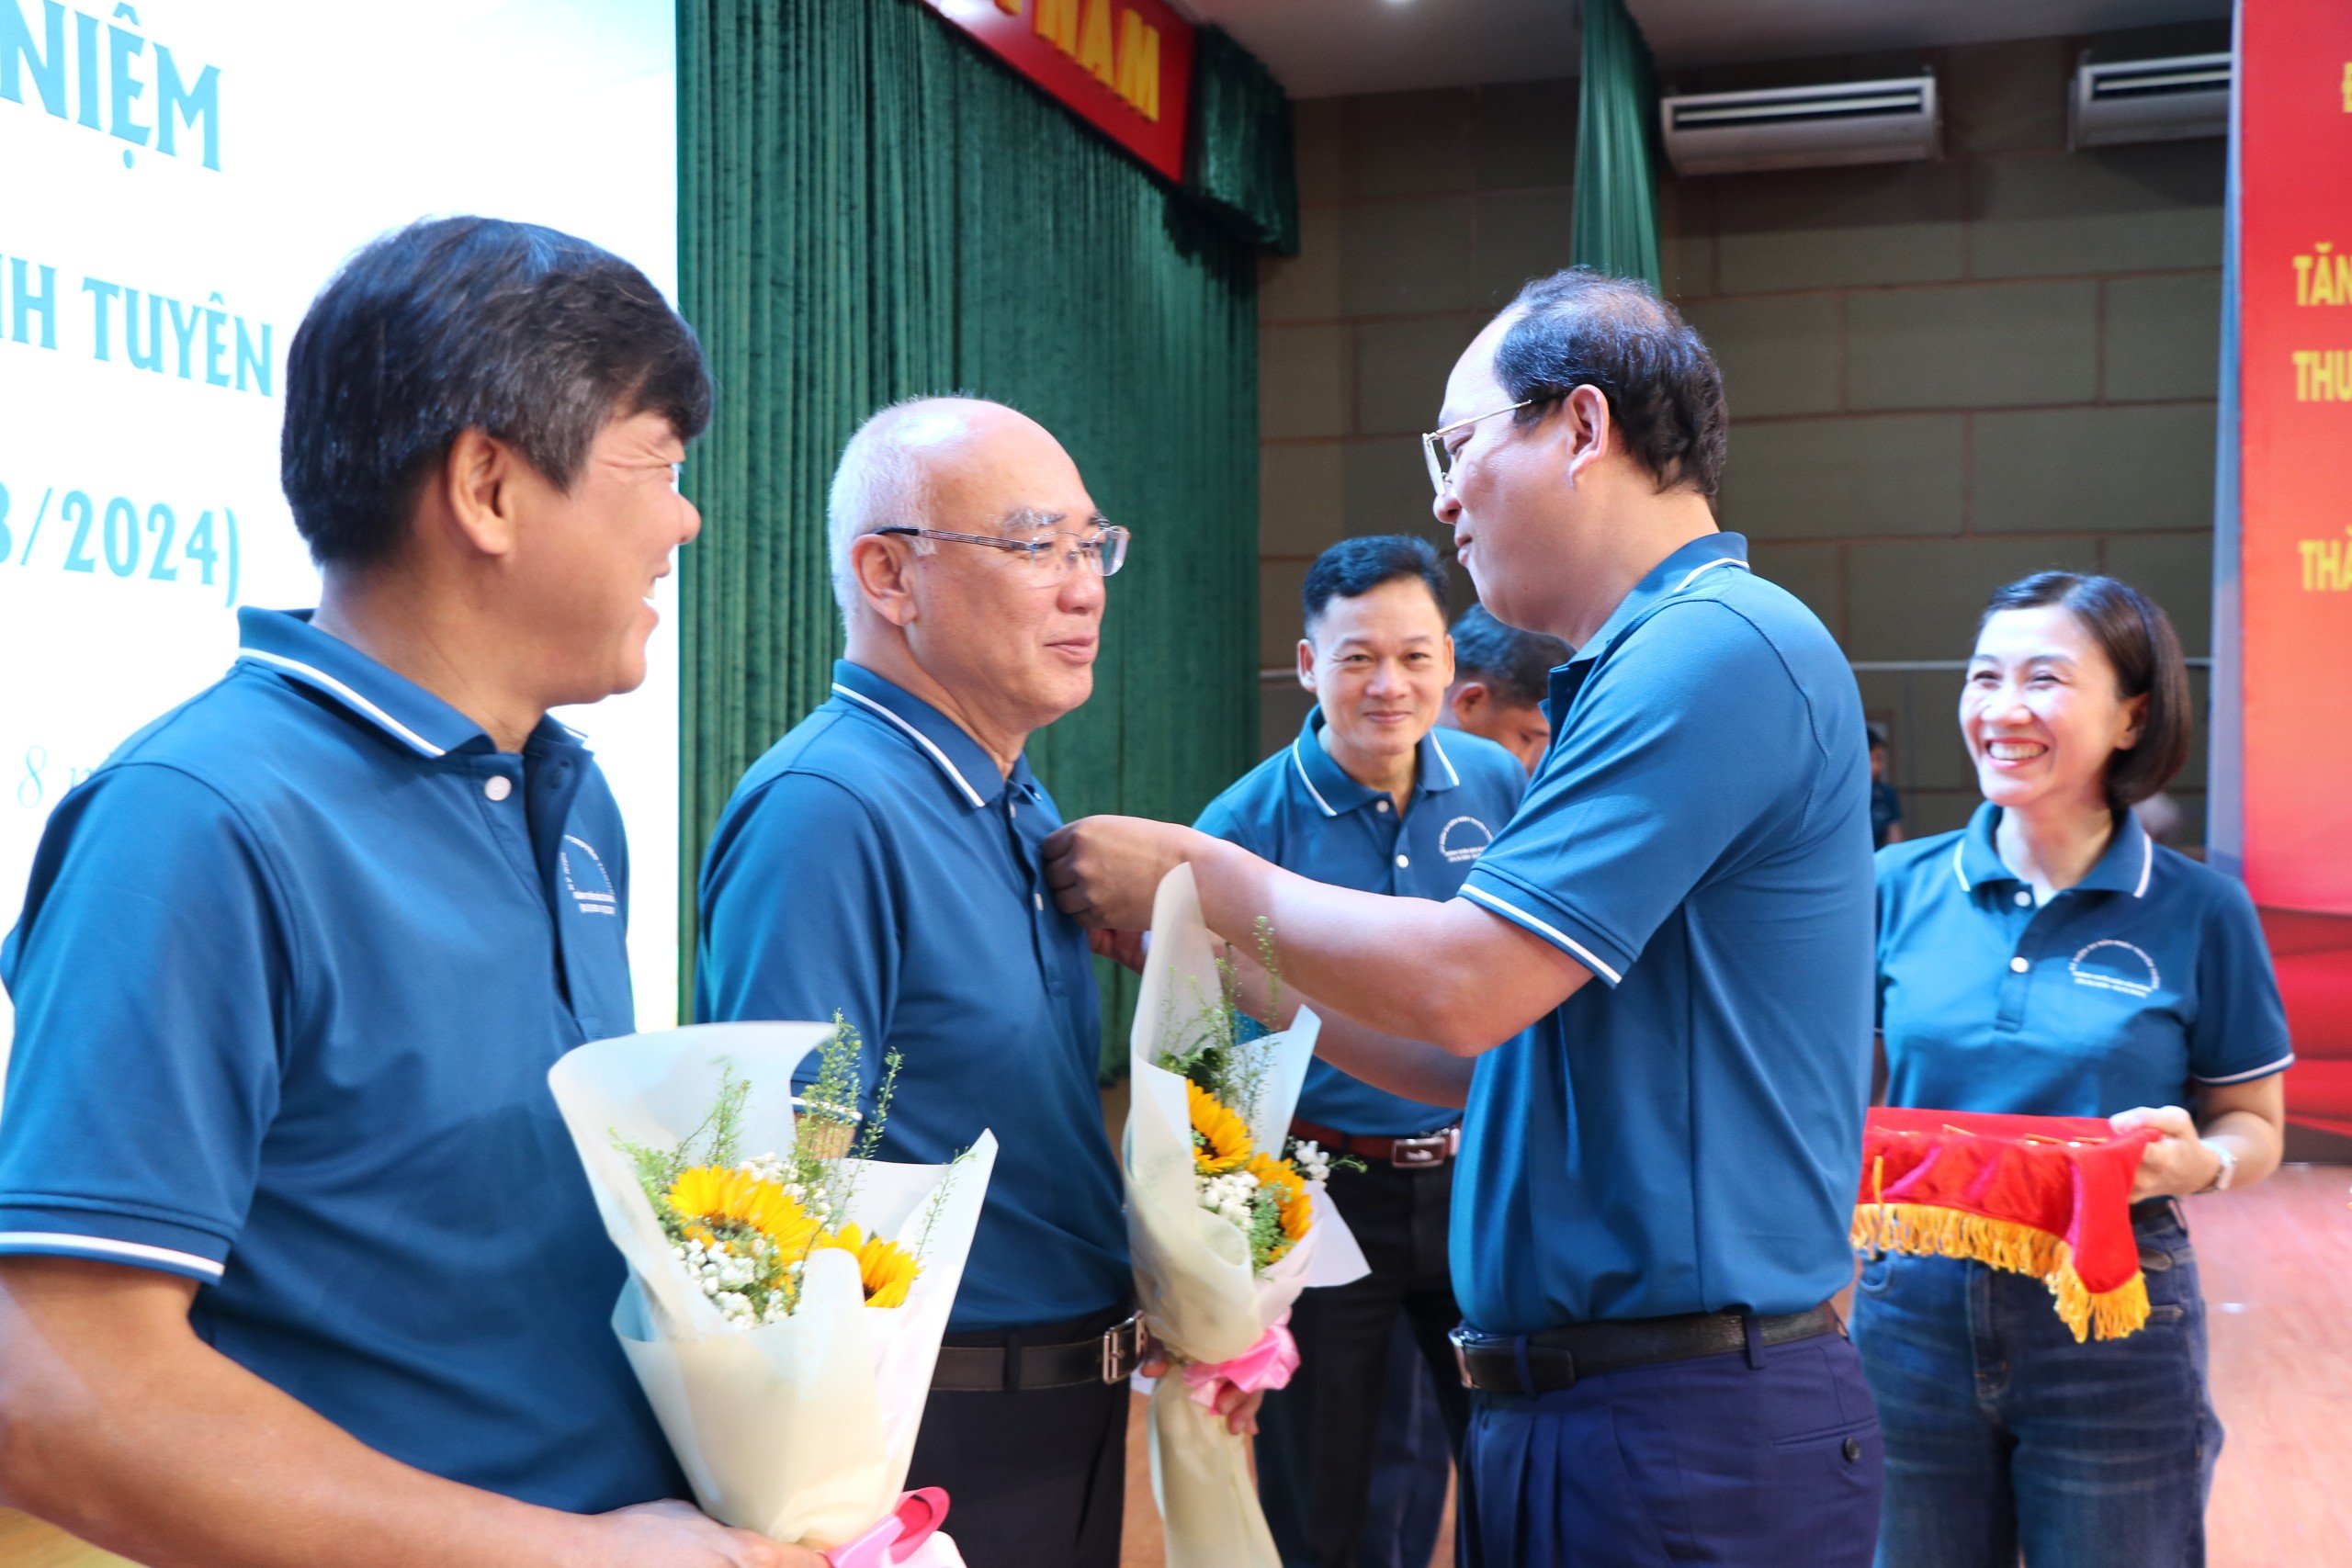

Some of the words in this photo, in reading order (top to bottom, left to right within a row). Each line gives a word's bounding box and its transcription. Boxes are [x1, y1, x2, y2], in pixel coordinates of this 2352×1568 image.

[0, 0, 222, 172] NIỆM
[82, 276, 273, 397] TUYÊN
[17, 745, 47, 808] 8
